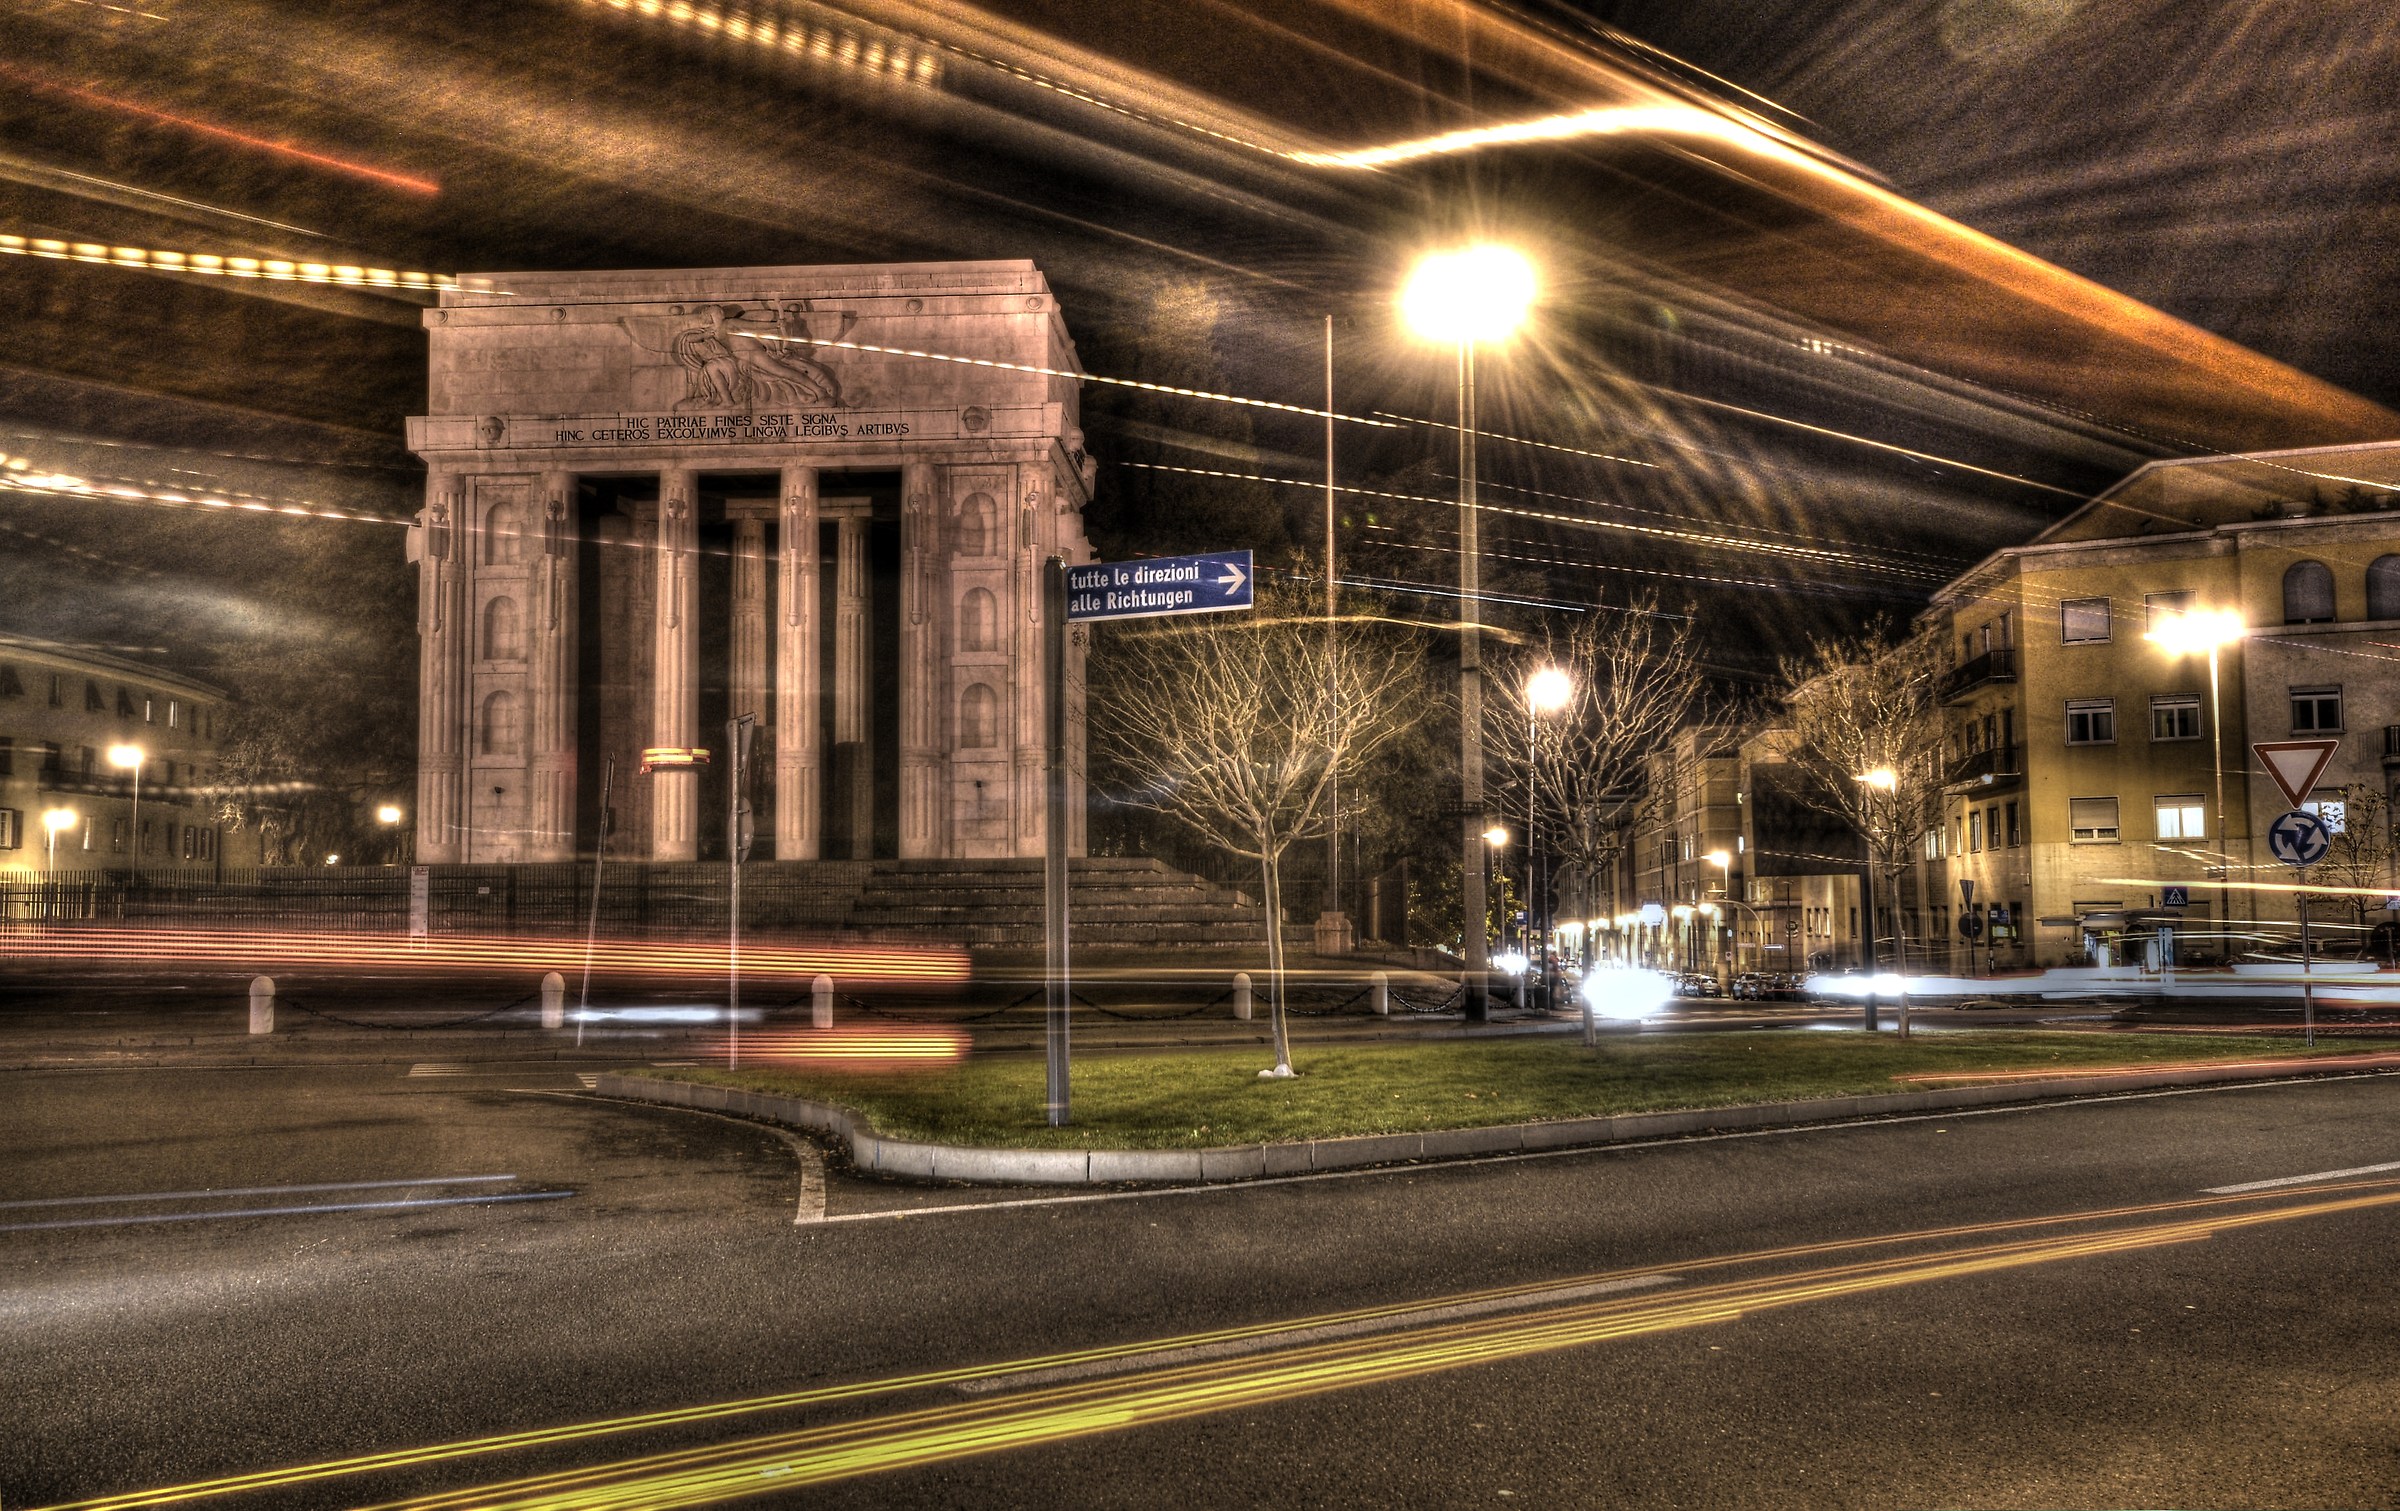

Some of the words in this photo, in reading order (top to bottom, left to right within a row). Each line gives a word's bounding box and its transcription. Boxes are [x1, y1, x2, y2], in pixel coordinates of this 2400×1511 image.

[627, 417, 649, 429] HIC
[657, 416, 706, 428] PATRIAE
[715, 415, 751, 427] FINES
[759, 414, 794, 426] SISTE
[801, 414, 837, 425] SIGNA
[556, 430, 584, 442] HINC
[592, 429, 650, 441] CETEROS
[658, 427, 736, 440] EXCOLVIMVS
[744, 426, 787, 438] LINGVA
[795, 425, 848, 436] LEGIBVS
[857, 423, 910, 435] ARTIBVS
[1071, 571, 1108, 590] tutte
[1114, 568, 1129, 586] le
[1134, 561, 1199, 584] direzioni
[1071, 594, 1101, 612] alle
[1107, 589, 1193, 609] Richtungen
